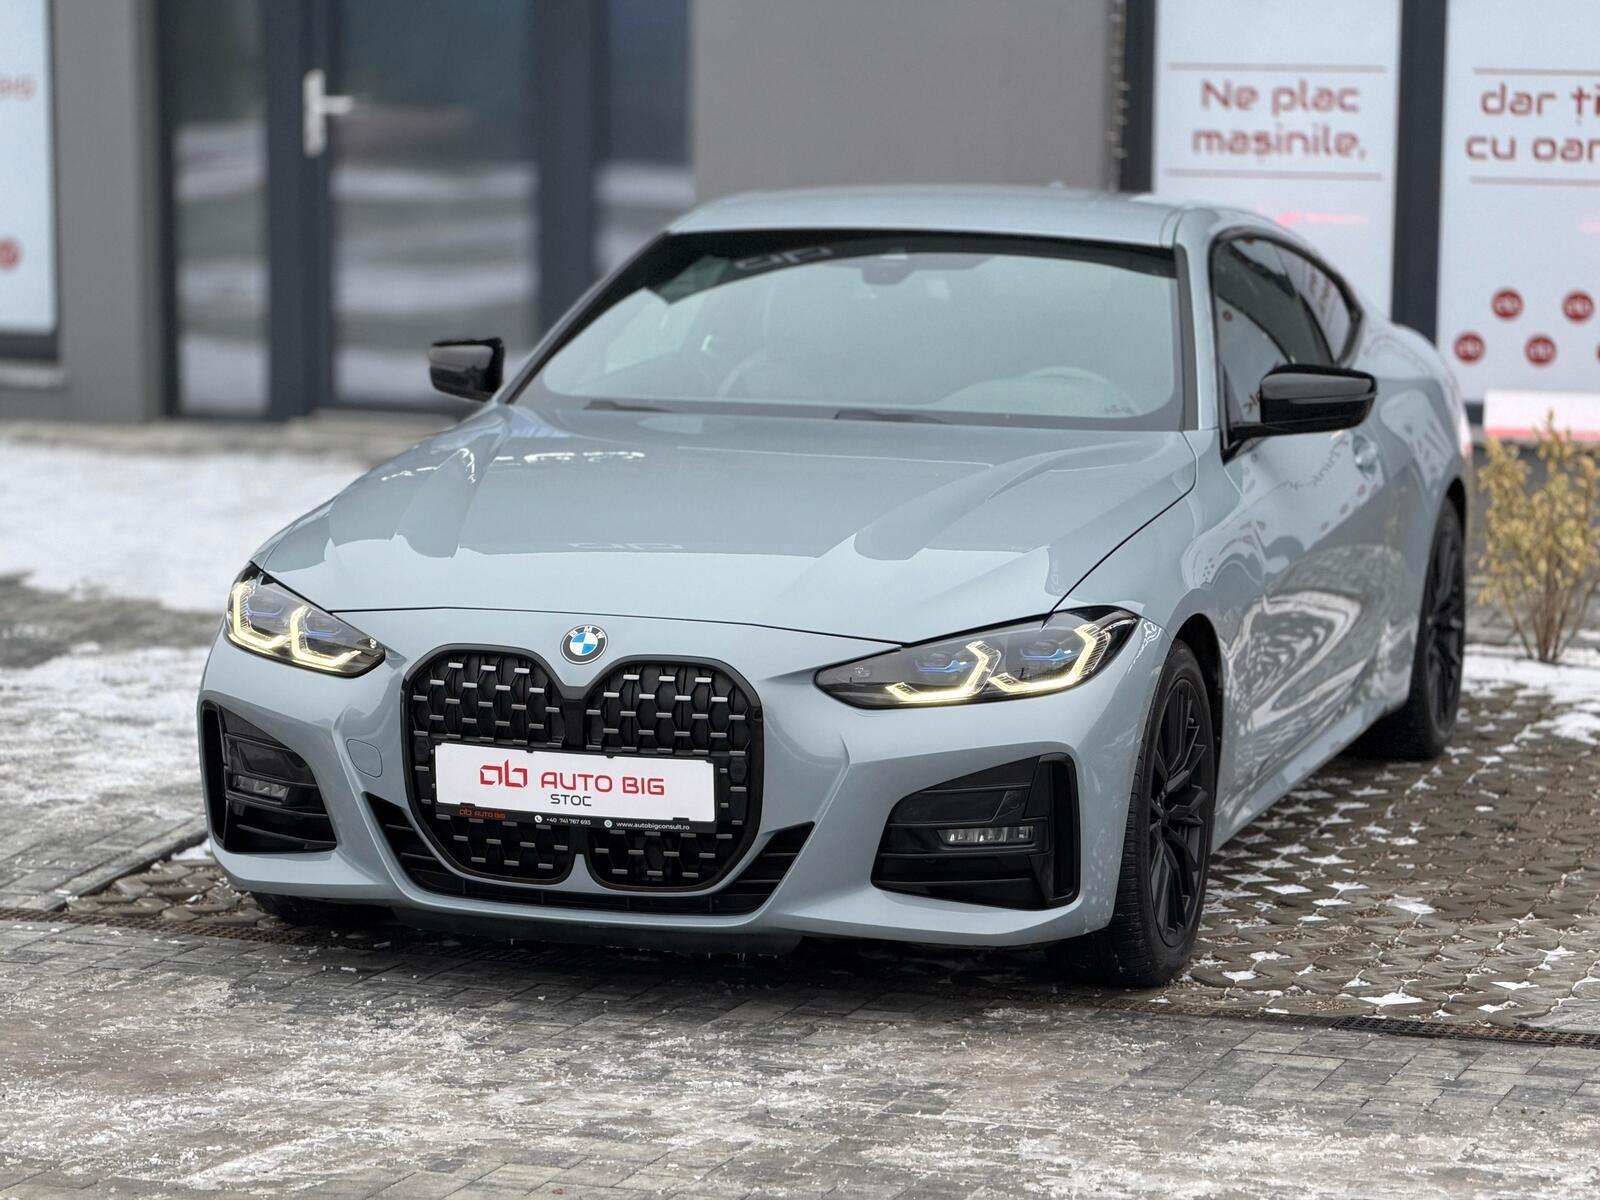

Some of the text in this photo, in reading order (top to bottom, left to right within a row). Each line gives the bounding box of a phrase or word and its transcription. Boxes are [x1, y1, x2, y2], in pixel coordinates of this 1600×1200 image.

[1201, 77, 1361, 117] Ne plac
[1480, 81, 1557, 116] dar
[1466, 135, 1517, 161] cu
[541, 771, 613, 793] AUTO
[622, 776, 665, 796] BIG
[550, 793, 592, 807] STOC
[474, 810, 493, 818] AUTO
[616, 822, 690, 830] www.autobigconsult.ro
